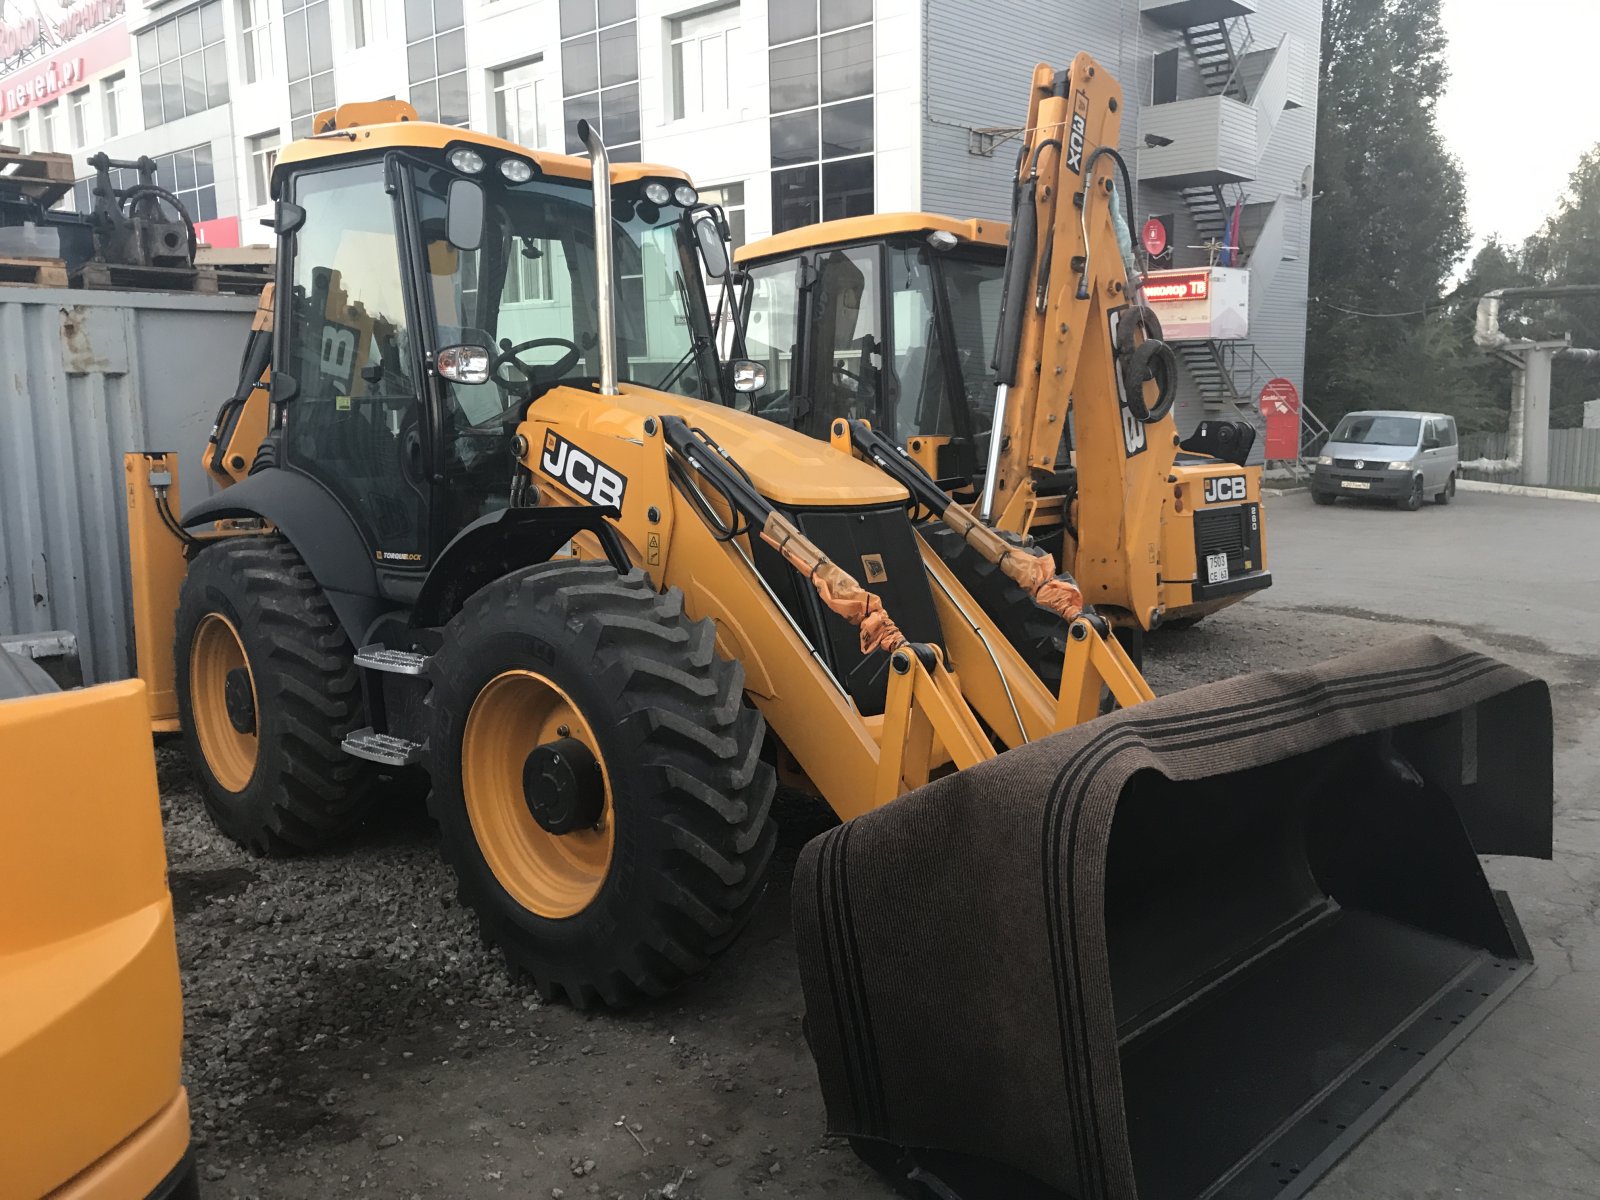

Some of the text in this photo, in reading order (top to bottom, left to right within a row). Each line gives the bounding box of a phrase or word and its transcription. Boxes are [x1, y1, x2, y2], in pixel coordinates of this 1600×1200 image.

[1067, 114, 1085, 171] 3CX
[1143, 284, 1187, 298] иколор
[543, 441, 624, 510] JCB
[1205, 476, 1246, 502] JCB
[1209, 555, 1225, 569] 7503
